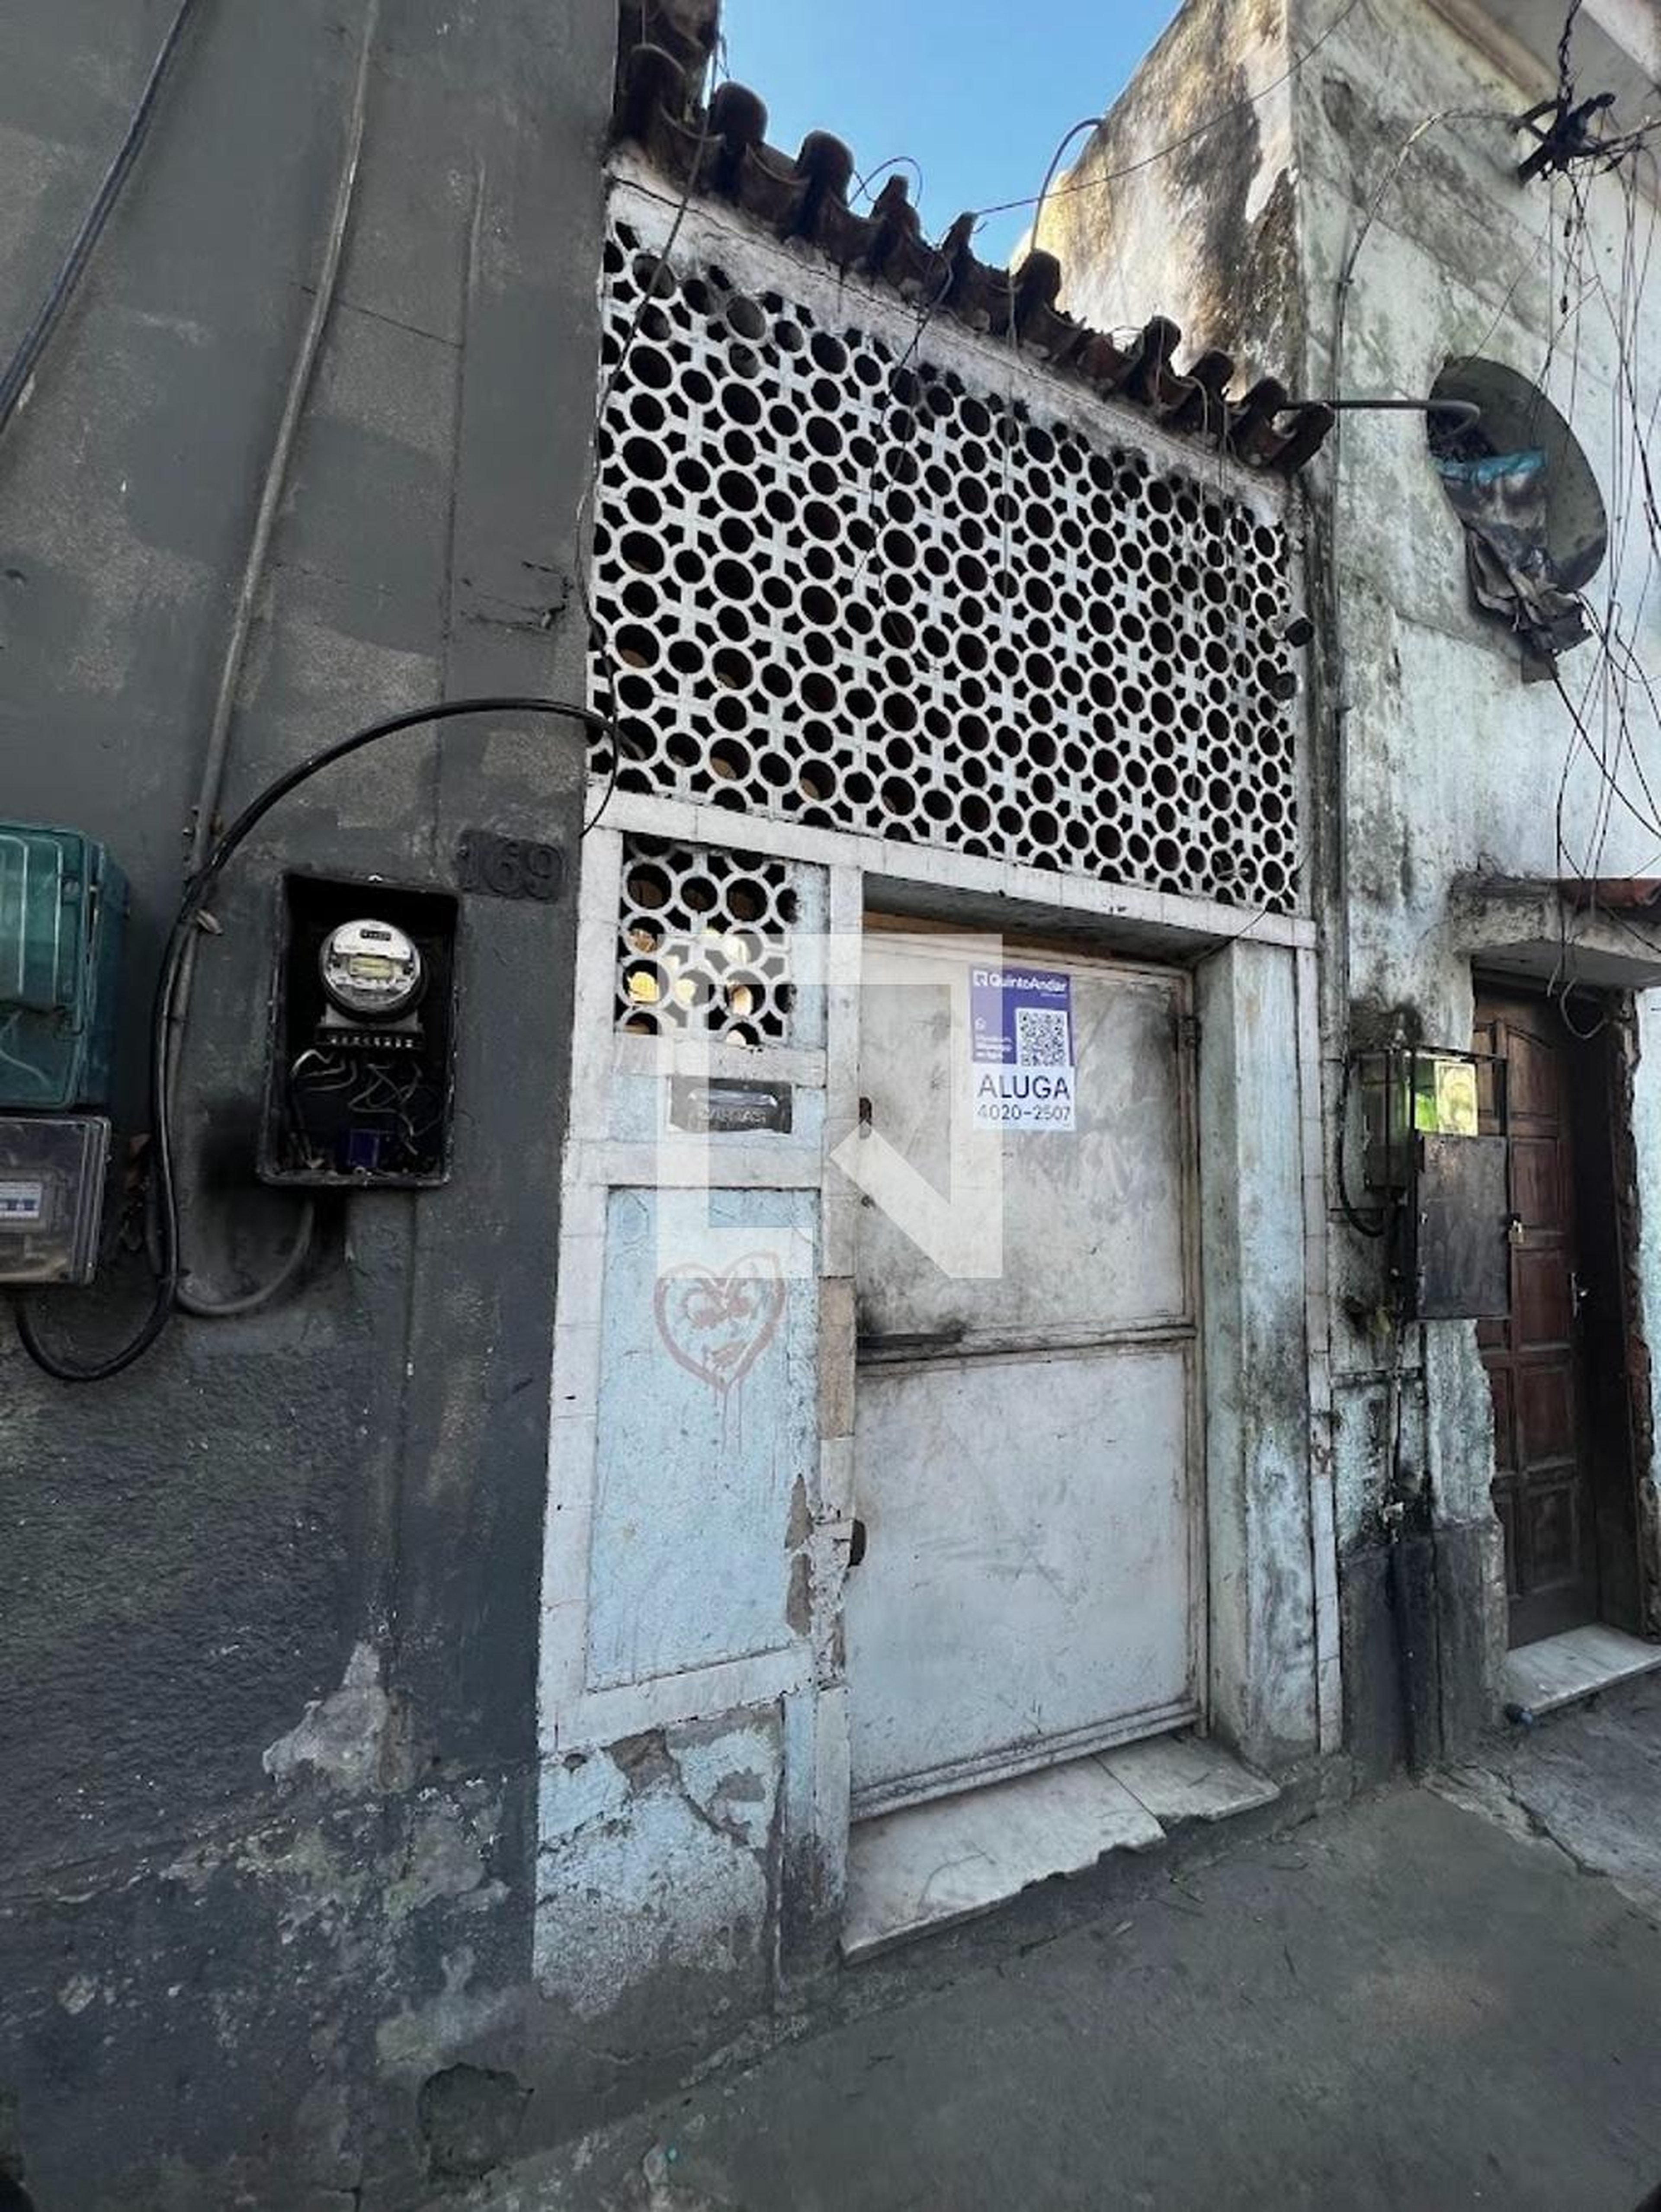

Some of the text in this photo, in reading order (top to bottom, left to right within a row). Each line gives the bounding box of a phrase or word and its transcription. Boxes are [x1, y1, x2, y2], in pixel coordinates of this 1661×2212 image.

[459, 831, 563, 900] 169
[989, 973, 1067, 992] QuintoAndar
[977, 1074, 1070, 1100] ALUGA
[977, 1104, 1071, 1121] 4020-2507
